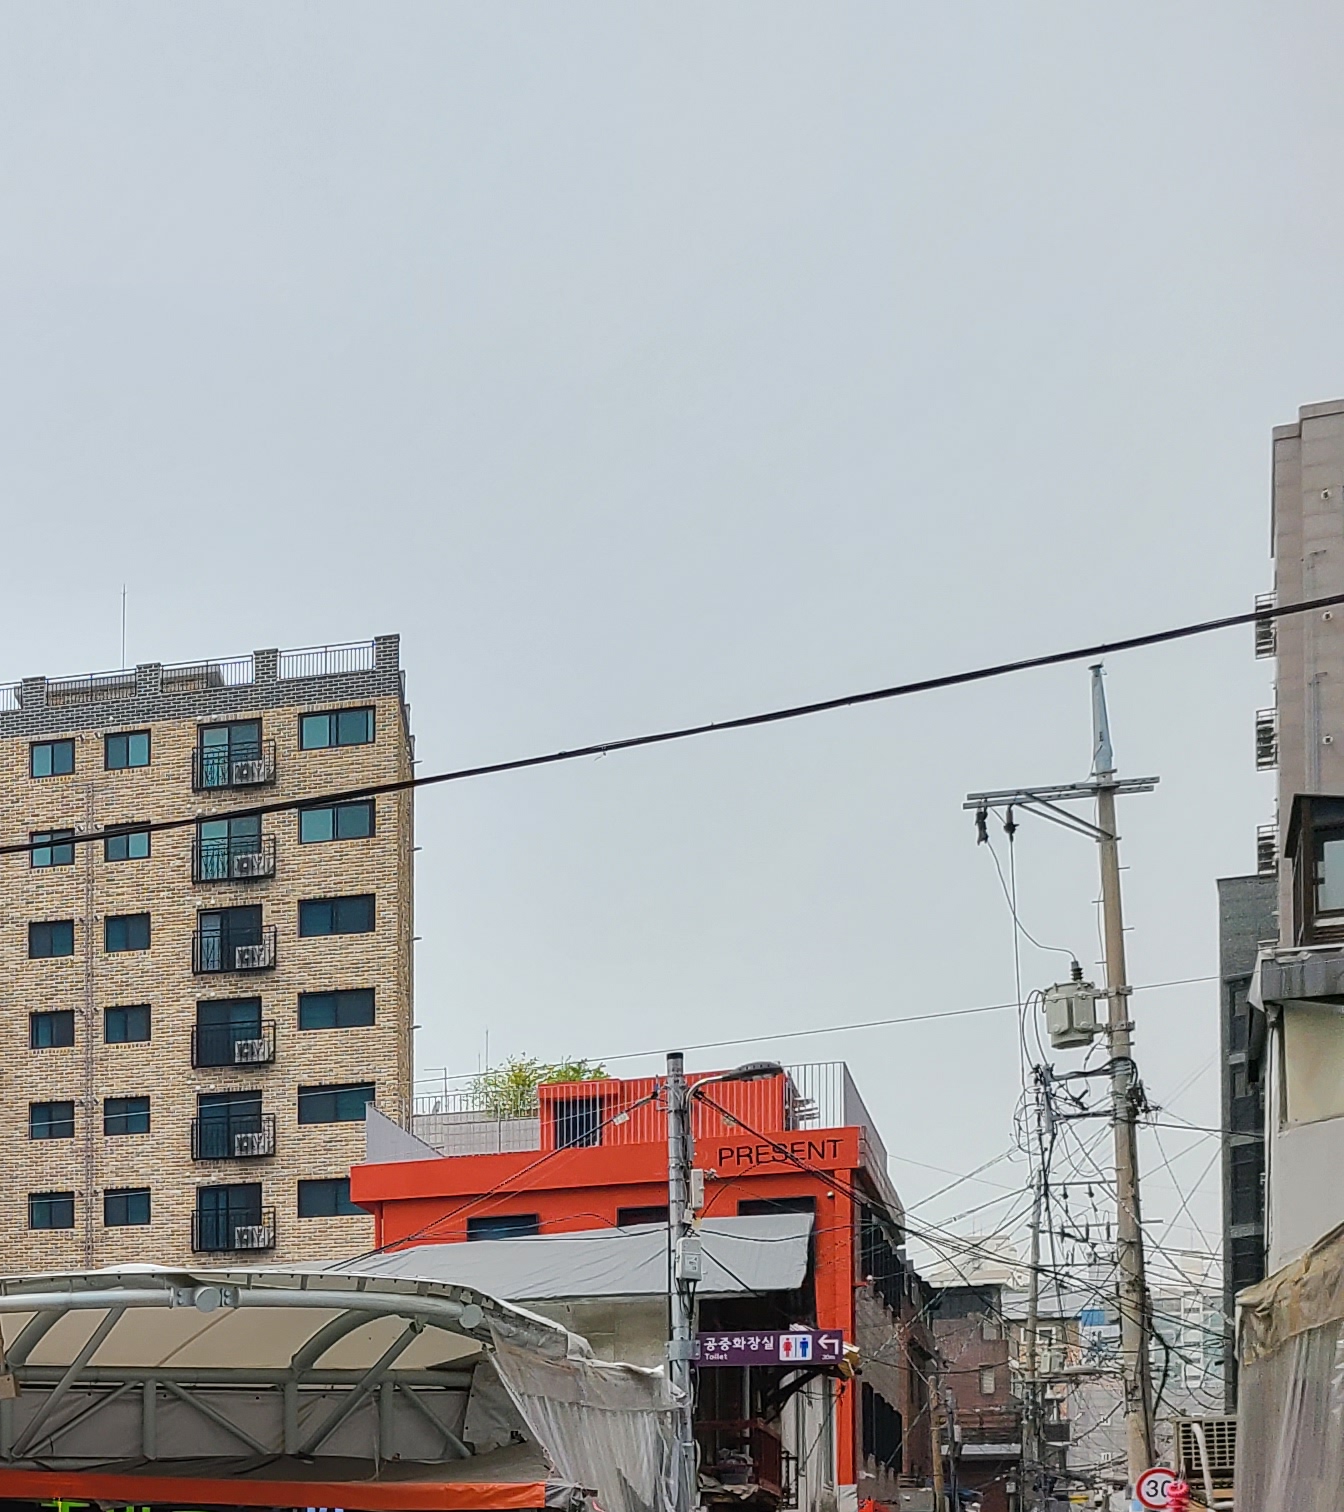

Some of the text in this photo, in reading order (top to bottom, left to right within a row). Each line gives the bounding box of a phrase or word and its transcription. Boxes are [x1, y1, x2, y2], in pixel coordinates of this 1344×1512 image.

[717, 1138, 844, 1167] PRESENT
[703, 1336, 774, 1351] 공중화장실
[704, 1352, 728, 1361] Toilet
